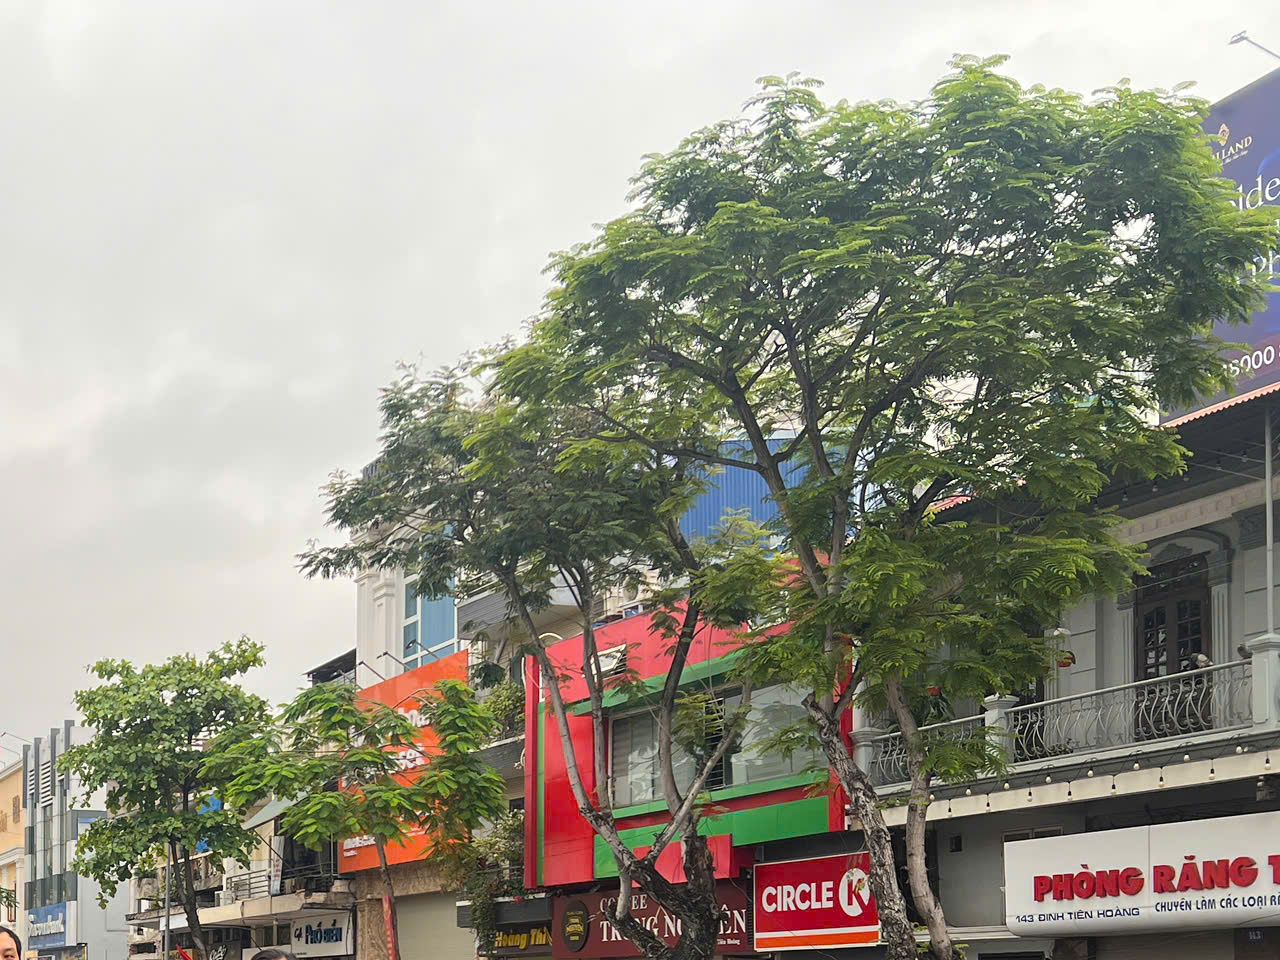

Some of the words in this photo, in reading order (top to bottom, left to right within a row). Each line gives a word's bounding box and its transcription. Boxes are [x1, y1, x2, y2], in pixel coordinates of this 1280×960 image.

[762, 881, 833, 912] CIRCLE
[841, 869, 870, 916] K
[1034, 864, 1144, 902] PHÒNG
[1153, 855, 1258, 893] RĂNG
[1016, 914, 1034, 922] 143
[1038, 912, 1065, 921] ĐINH
[1068, 910, 1093, 920] TIÊN
[1097, 906, 1140, 918] HOÀNG
[1155, 898, 1192, 912] CHUYÊN
[1196, 896, 1216, 910] LÀM
[1220, 893, 1238, 908] CÁC
[1242, 895, 1267, 909] LOẠI
